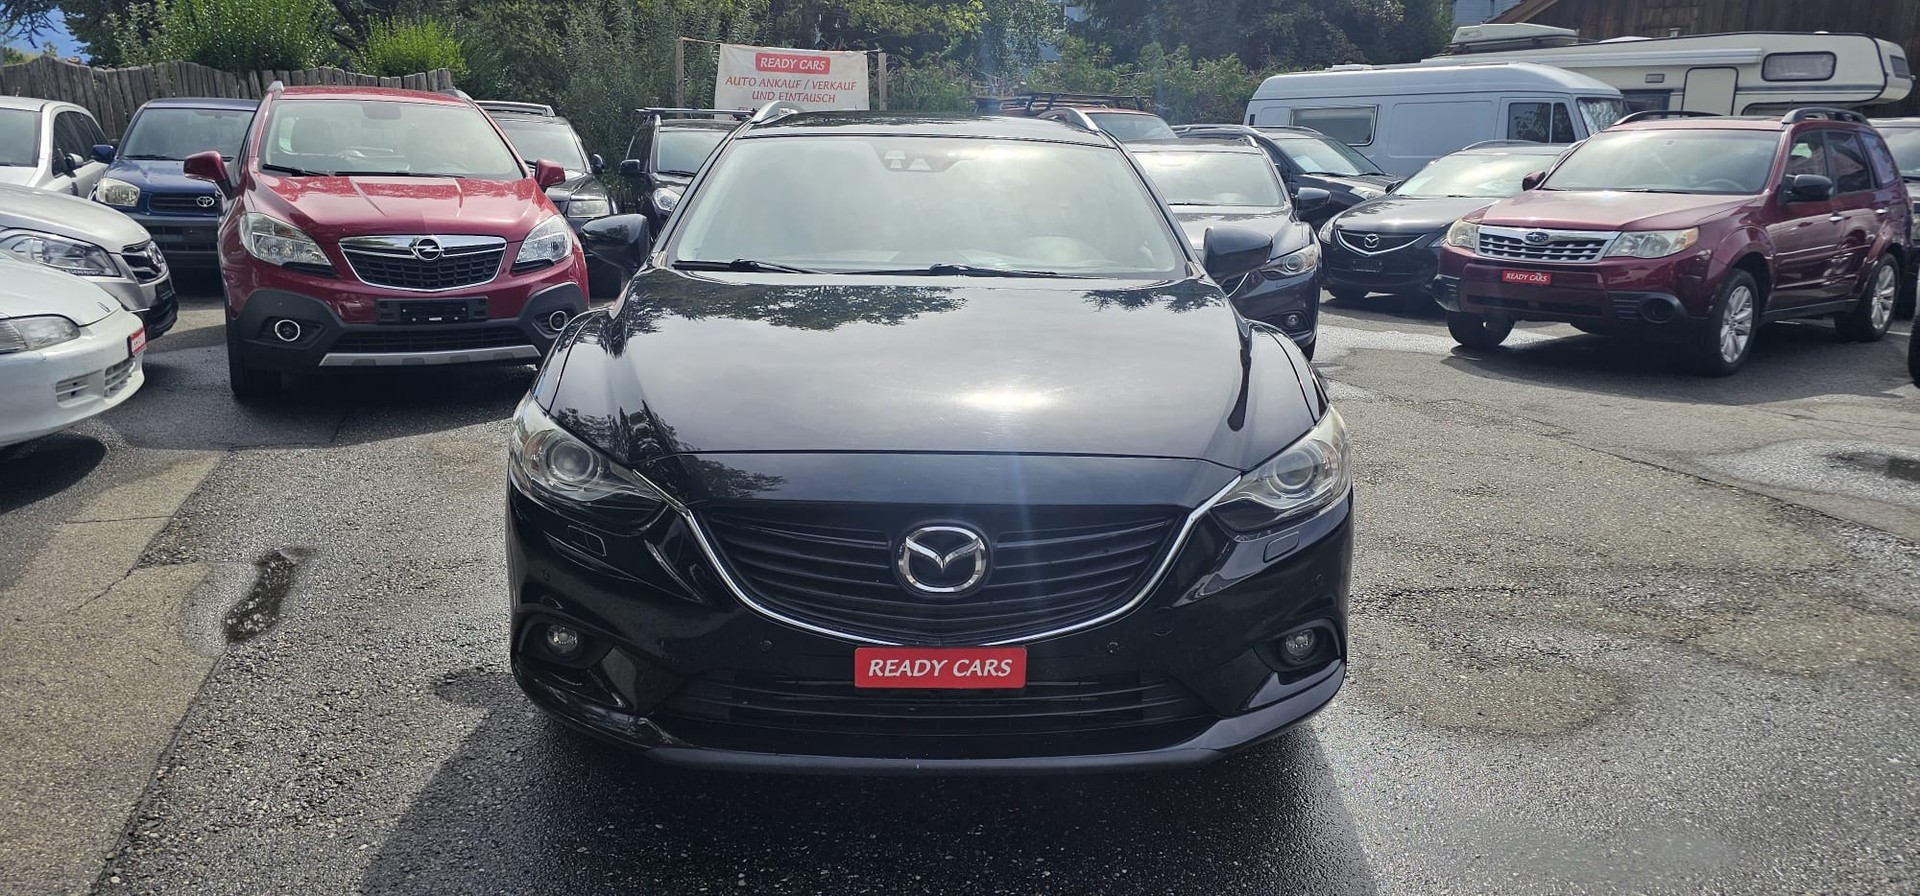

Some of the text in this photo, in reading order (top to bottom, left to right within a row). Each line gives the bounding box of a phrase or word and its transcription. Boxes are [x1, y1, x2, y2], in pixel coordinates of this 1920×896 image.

[760, 57, 826, 71] READY CARS
[725, 76, 858, 91] AUTO ANKAUF / VERKAUF
[752, 90, 836, 103] UND EINTAUSCH
[1506, 272, 1548, 282] READY CARS
[868, 659, 1013, 677] READY CARS
